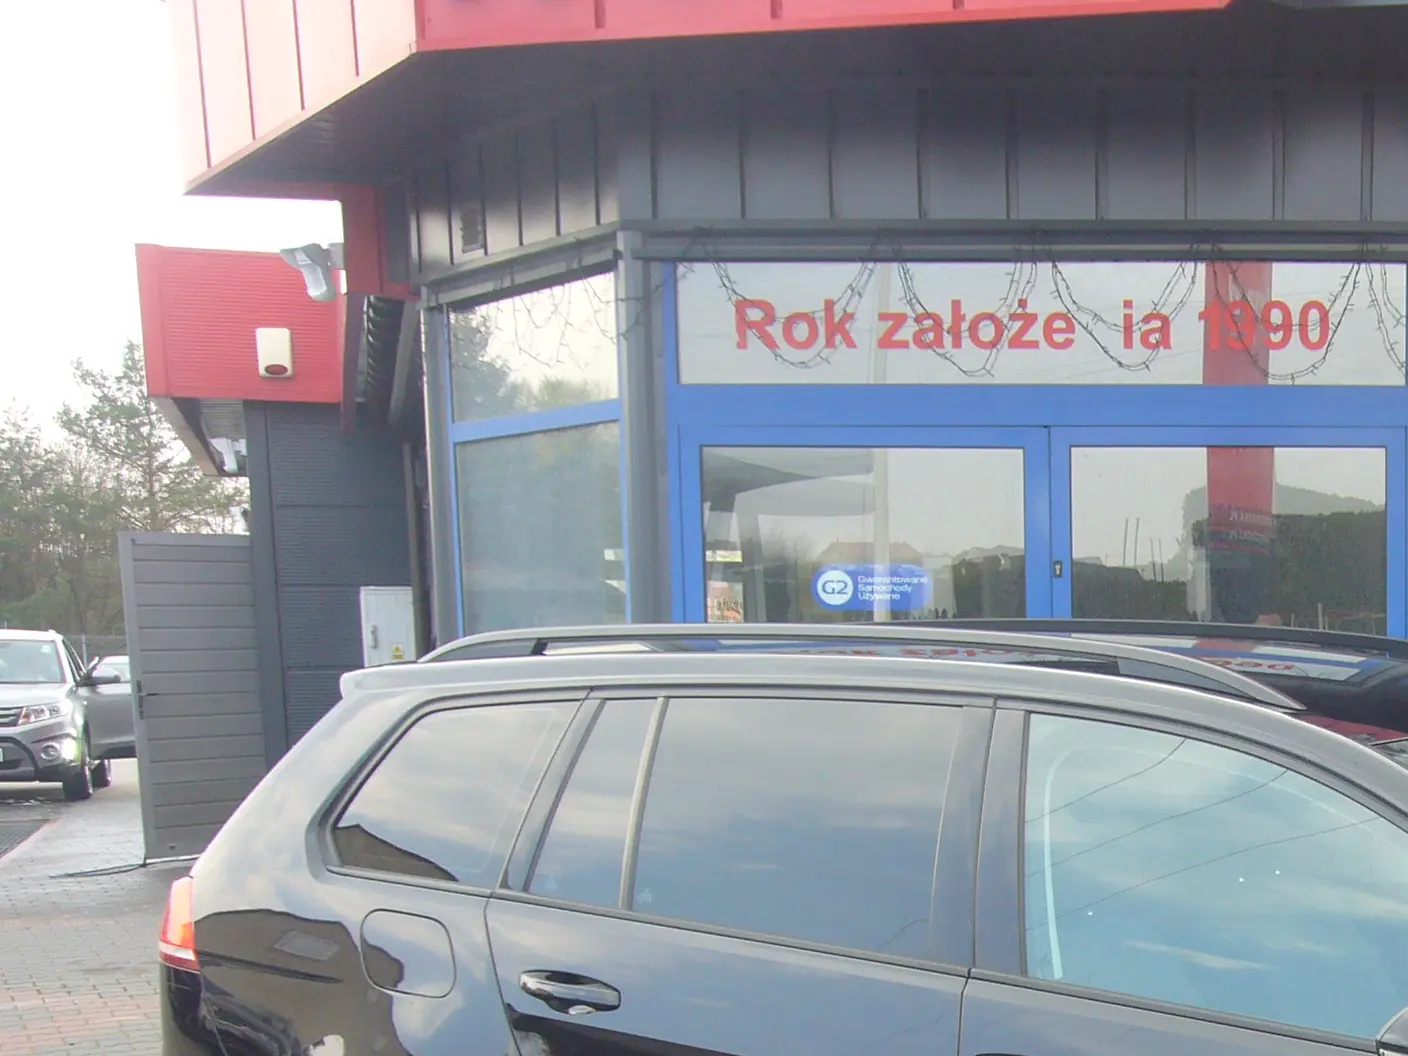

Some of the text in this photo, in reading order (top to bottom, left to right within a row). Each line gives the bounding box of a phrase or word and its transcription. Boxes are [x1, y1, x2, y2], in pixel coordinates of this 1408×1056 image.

[734, 298, 857, 350] Rok
[1198, 299, 1331, 350] 1990
[821, 579, 848, 595] G2
